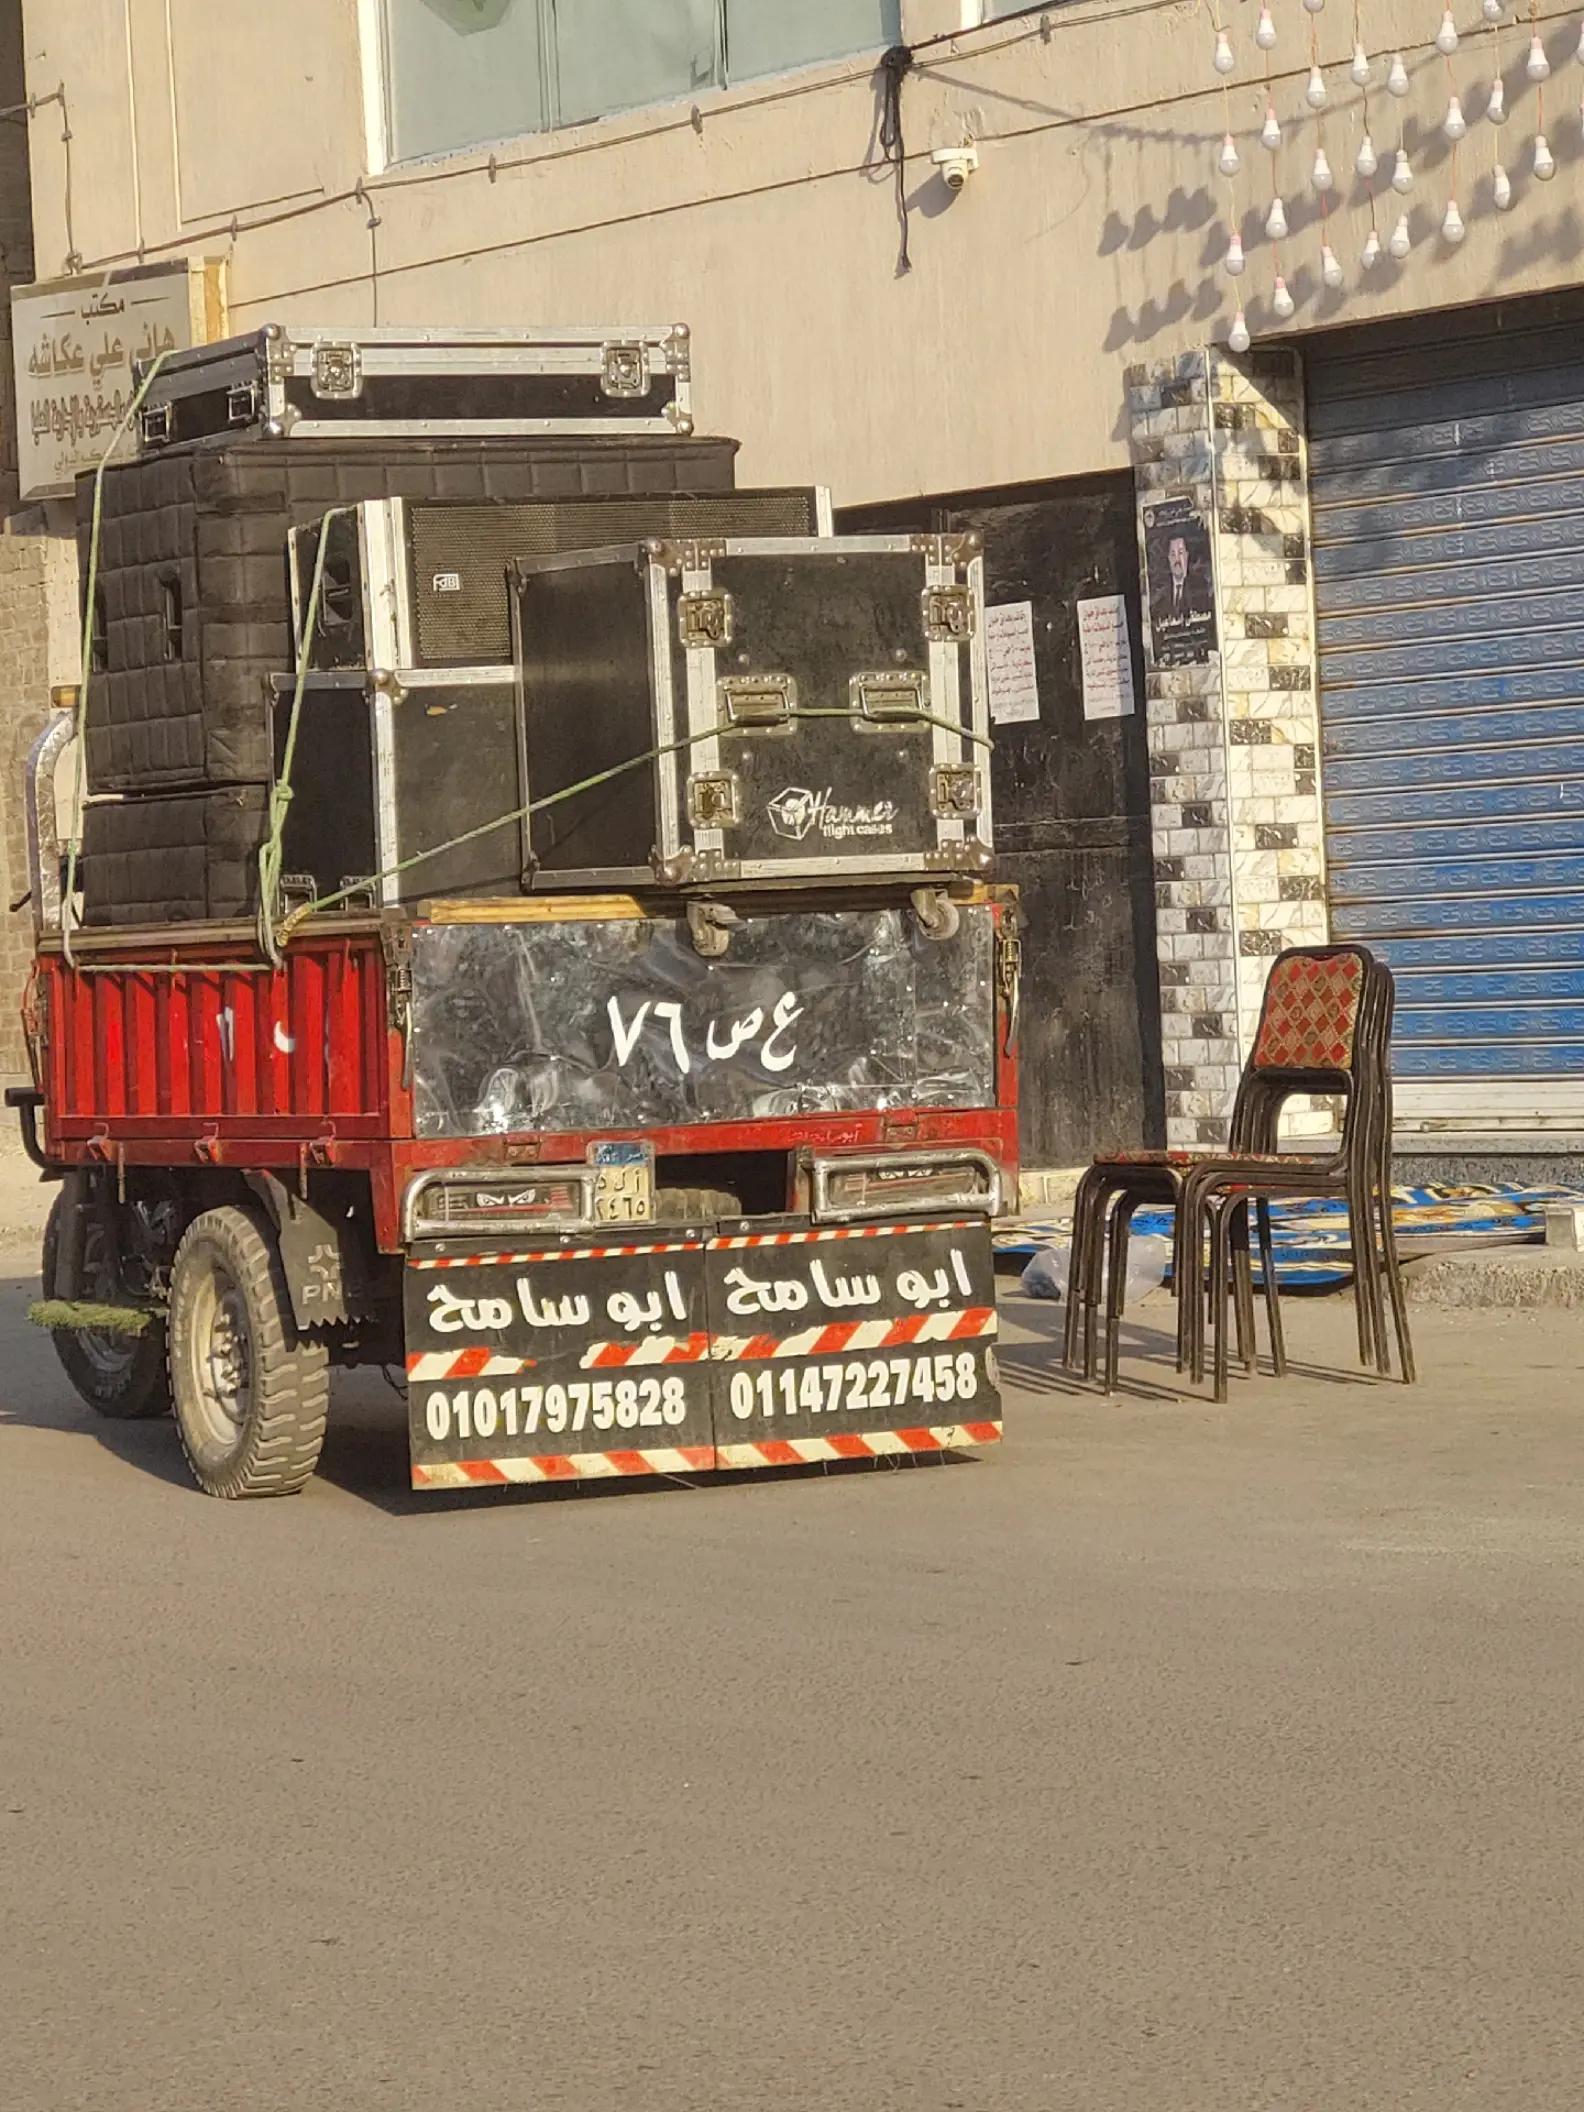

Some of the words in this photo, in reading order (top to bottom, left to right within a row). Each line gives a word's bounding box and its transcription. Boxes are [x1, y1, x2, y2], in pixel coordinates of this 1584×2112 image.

[81, 293, 125, 325] مكتب
[427, 1277, 590, 1333] سامح
[607, 1271, 687, 1331] ابو
[723, 1259, 881, 1315] سامح
[896, 1248, 972, 1308] ابو
[426, 1376, 687, 1441] 01017975828
[730, 1352, 977, 1420] 01147227458
